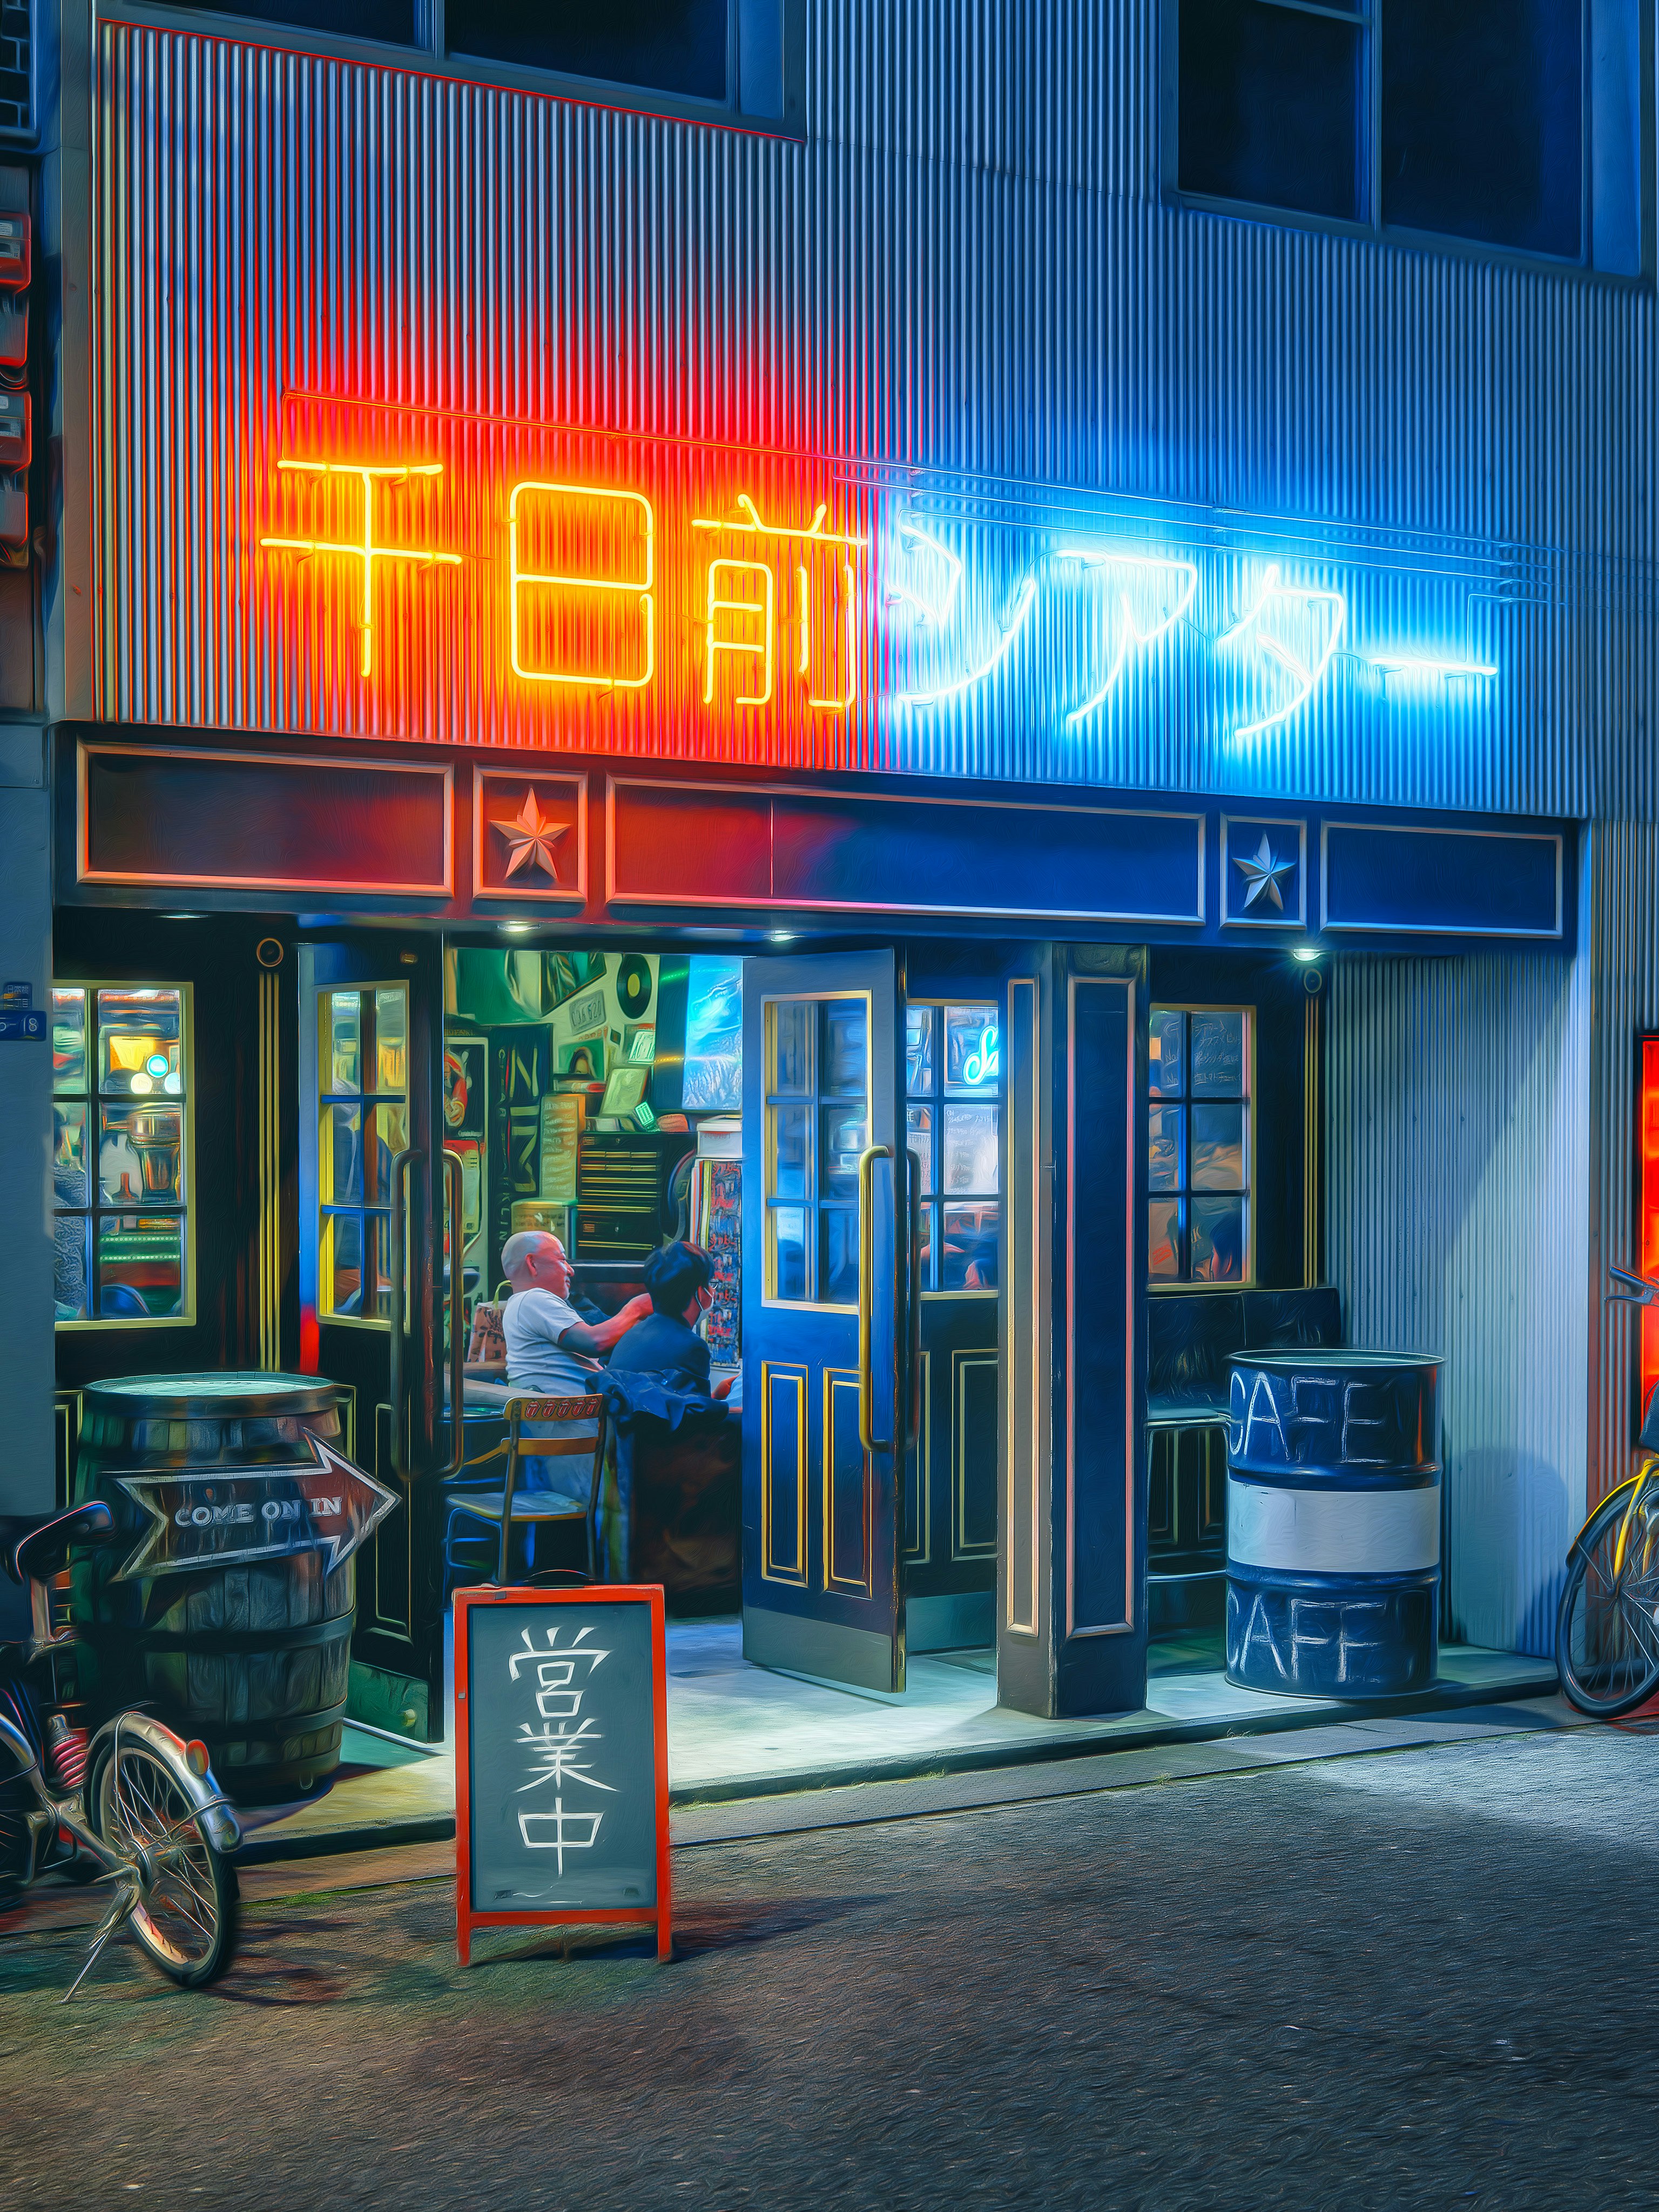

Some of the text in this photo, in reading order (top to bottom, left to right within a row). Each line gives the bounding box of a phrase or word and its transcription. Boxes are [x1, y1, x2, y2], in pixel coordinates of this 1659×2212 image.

[8, 985, 29, 994] 日本橋
[174, 1495, 343, 1528] COME ON IN
[509, 1624, 622, 1880] 営業中
